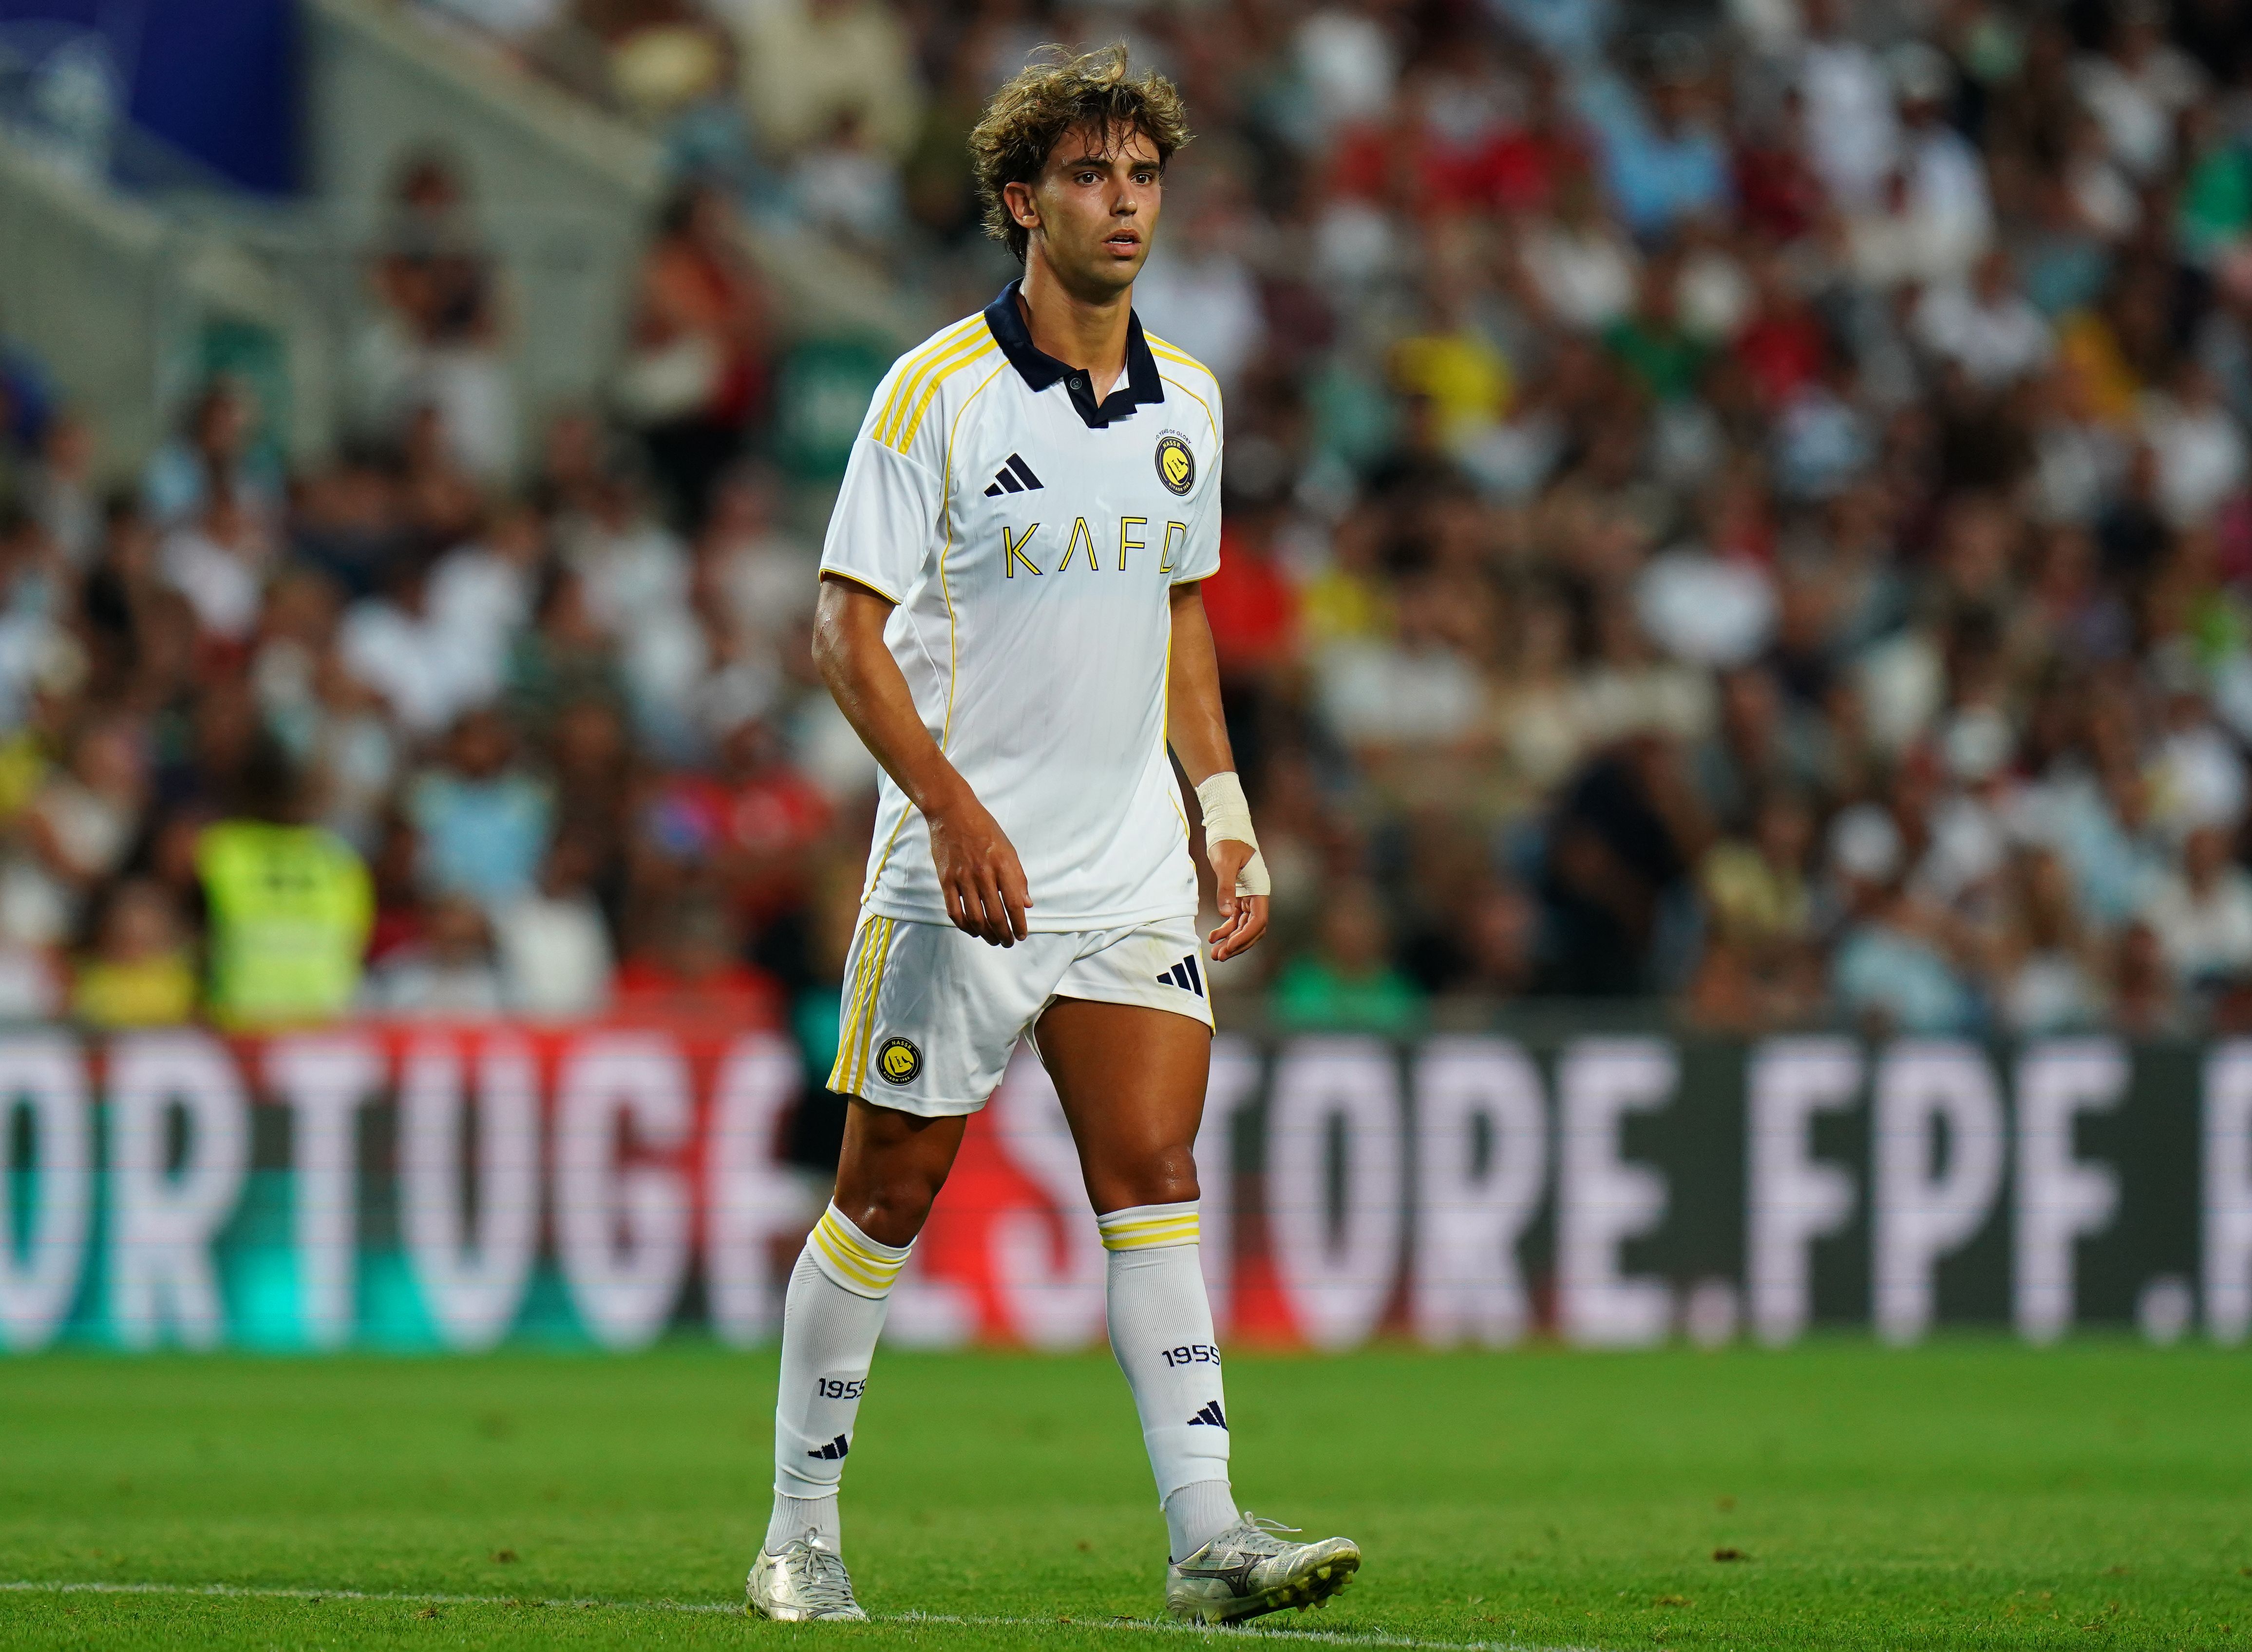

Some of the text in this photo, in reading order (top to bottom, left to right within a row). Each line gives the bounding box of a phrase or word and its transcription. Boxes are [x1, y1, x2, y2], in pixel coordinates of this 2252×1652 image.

[1162, 440, 1181, 449] NASSR
[1003, 516, 1187, 578] KAFD
[891, 1040, 912, 1050] NASSR
[1161, 1344, 1220, 1367] 1955
[819, 1377, 867, 1399] 1955
